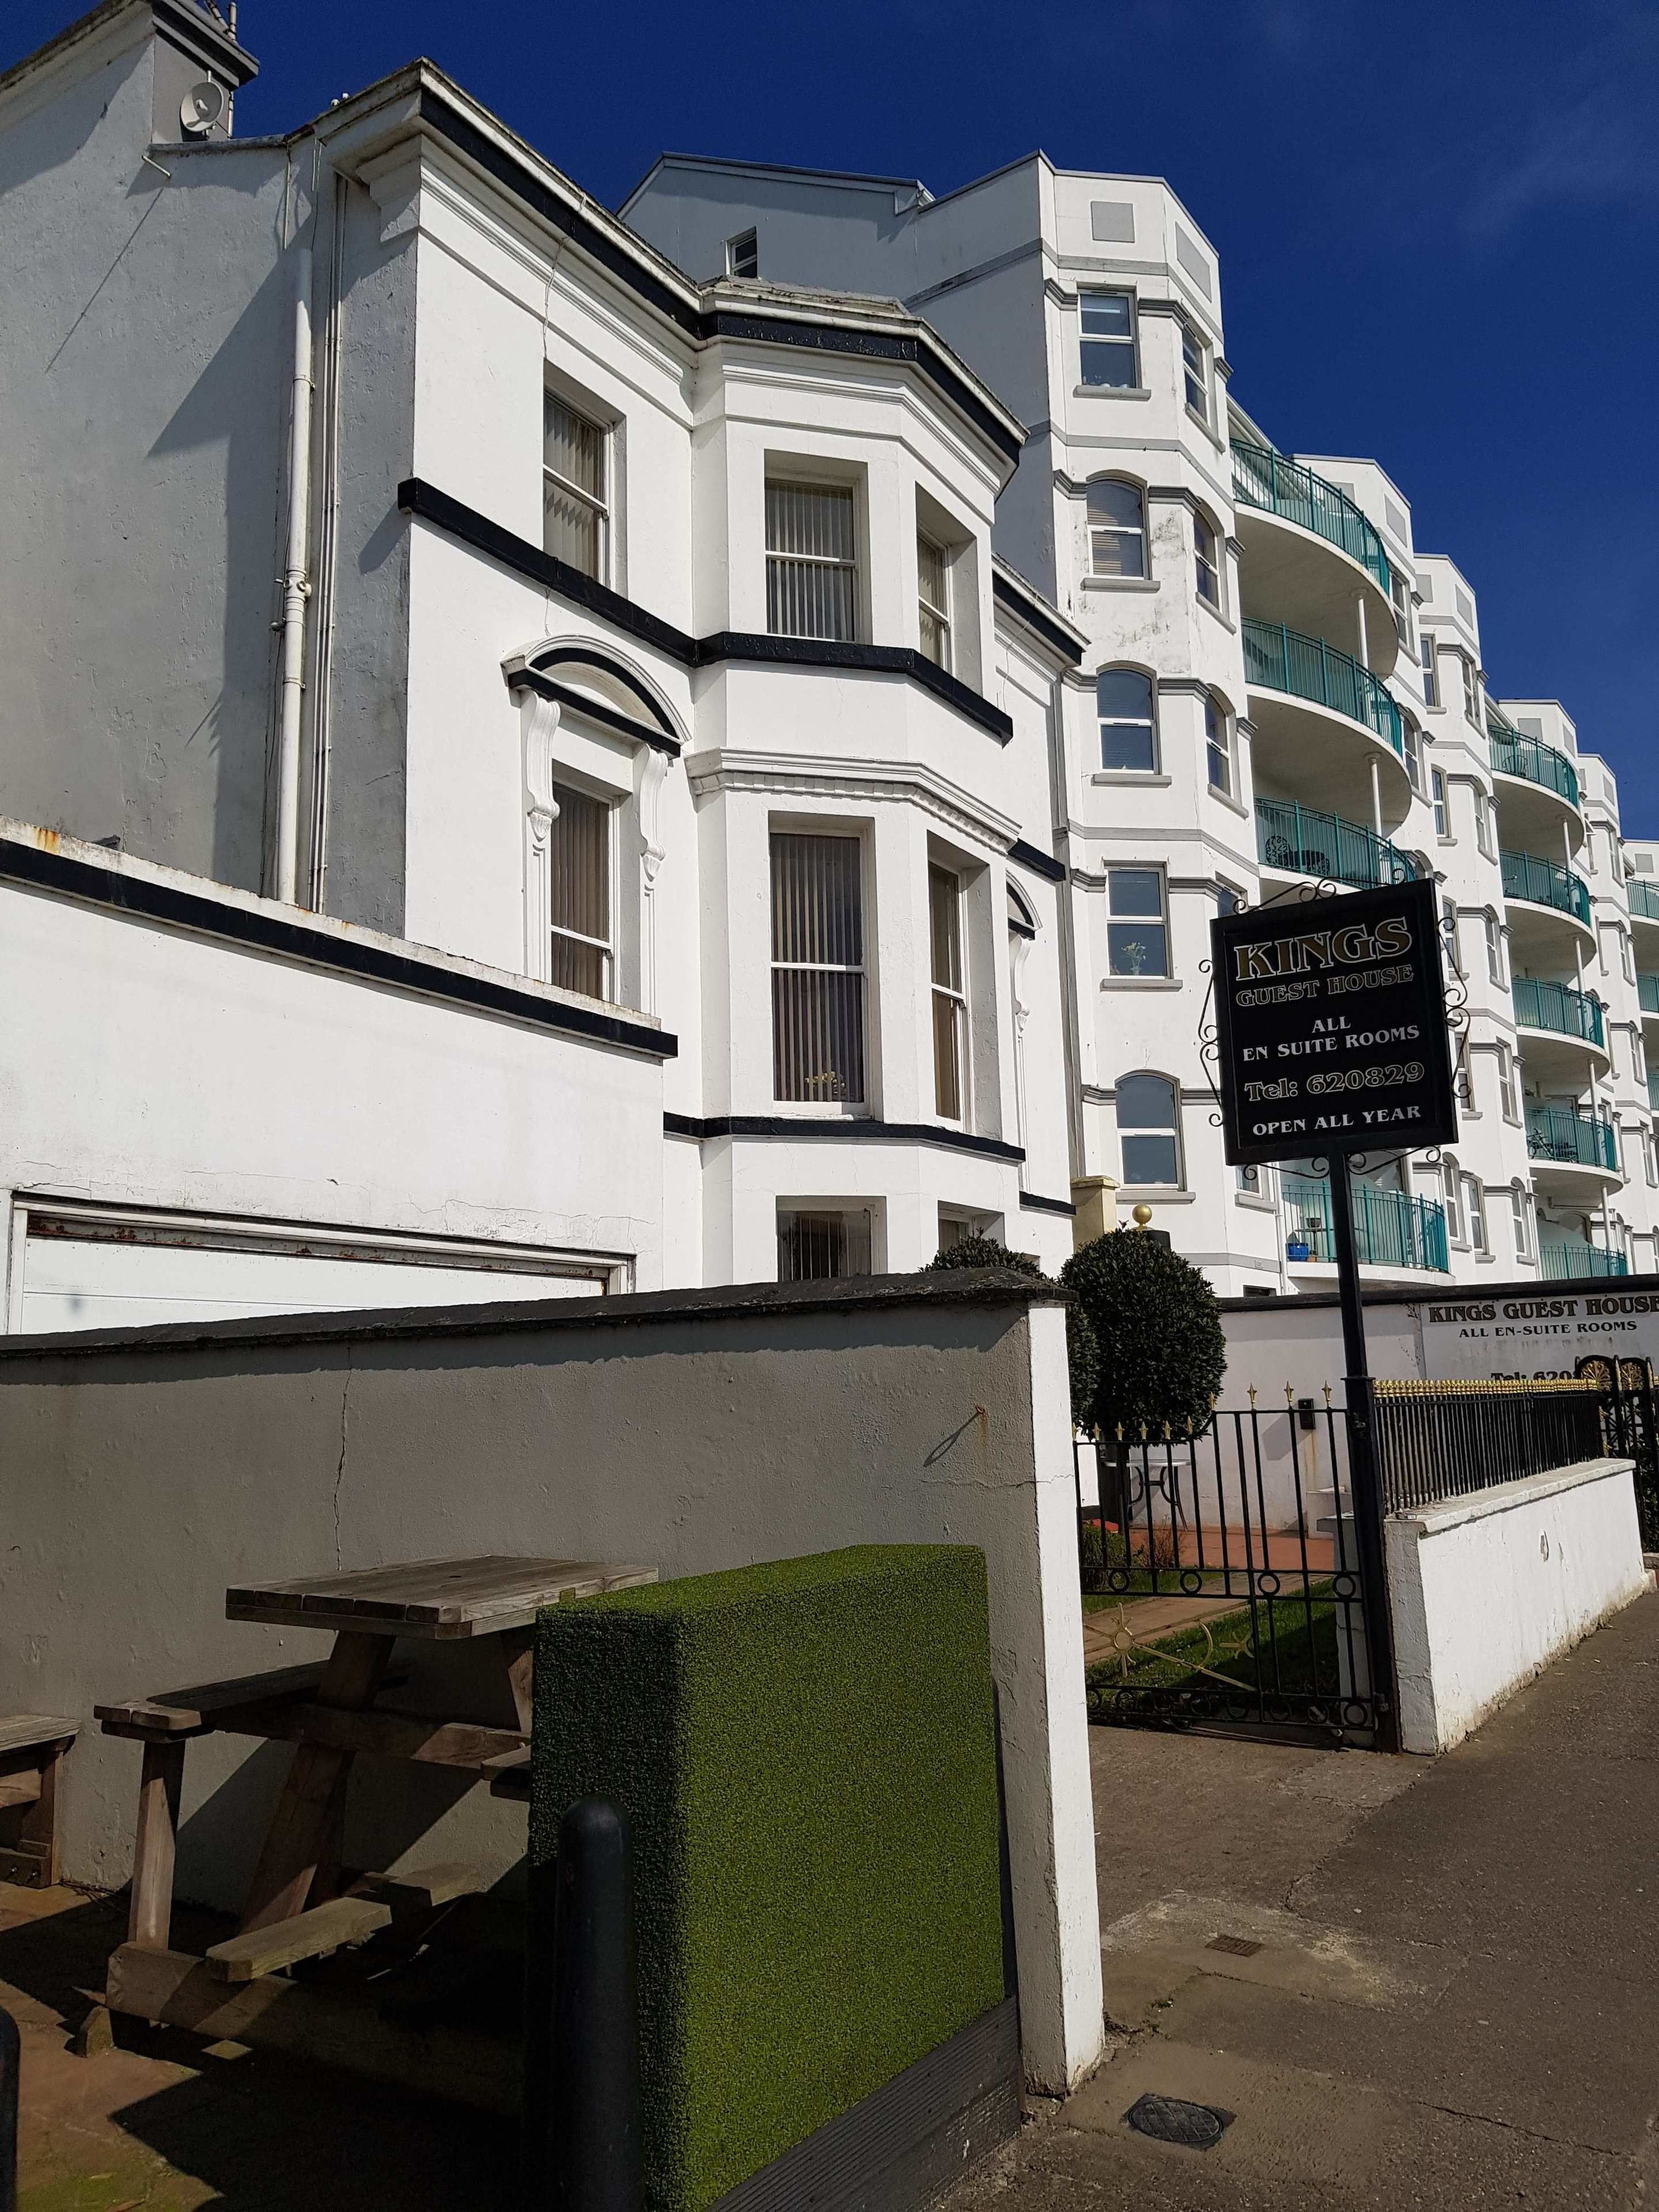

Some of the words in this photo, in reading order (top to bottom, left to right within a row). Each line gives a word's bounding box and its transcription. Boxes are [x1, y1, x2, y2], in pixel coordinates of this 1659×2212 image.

[1234, 916, 1412, 980] KINGS
[1236, 980, 1319, 1006] GUEST
[1328, 964, 1414, 994] HOUSE
[1312, 1016, 1351, 1033] ALL
[1243, 1046, 1268, 1061] EN
[1278, 1037, 1337, 1057] SUITE
[1346, 1025, 1419, 1048] ROOMS
[1244, 1078, 1298, 1101] Tel:
[1306, 1062, 1424, 1094] 620829
[1252, 1118, 1306, 1135] OPEN
[1314, 1113, 1354, 1128] ALL
[1362, 1105, 1422, 1123] YEAR
[1429, 1304, 1496, 1323] KINGS
[1503, 1300, 1578, 1319] GUEST
[1585, 1296, 1659, 1316] HOUSE
[1459, 1328, 1488, 1338] ALL
[1495, 1324, 1571, 1336] EN-SUITE
[1577, 1321, 1637, 1333] ROOMS
